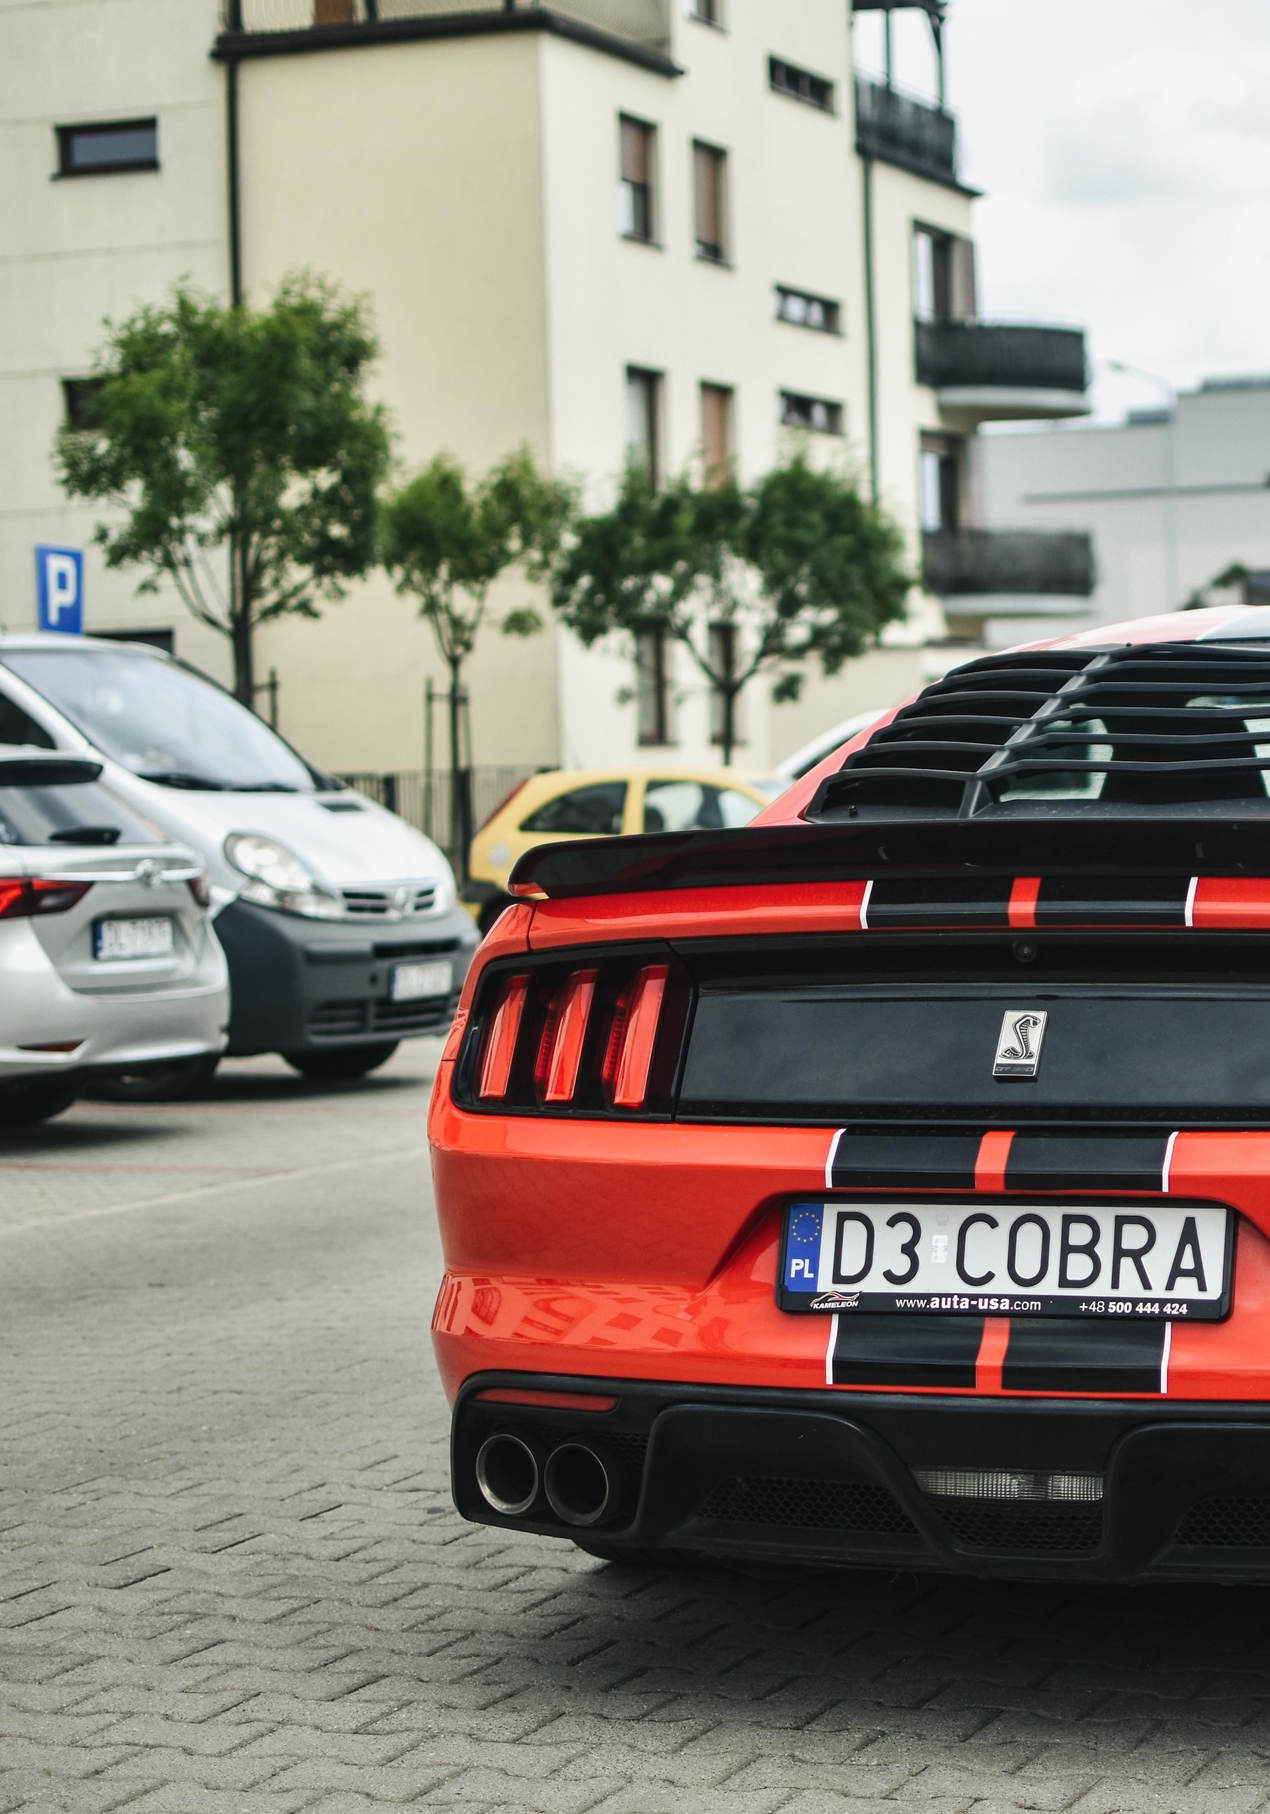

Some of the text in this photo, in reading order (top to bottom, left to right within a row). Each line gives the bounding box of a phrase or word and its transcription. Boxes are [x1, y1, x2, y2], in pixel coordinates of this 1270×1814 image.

[46, 553, 77, 625] P
[832, 1211, 1208, 1291] D3 COBRA
[790, 1258, 815, 1278] PL
[812, 1301, 859, 1310] KAMELEON
[895, 1295, 1042, 1311] www.auta-usa.com
[1079, 1301, 1188, 1315] +48 500 444 424
